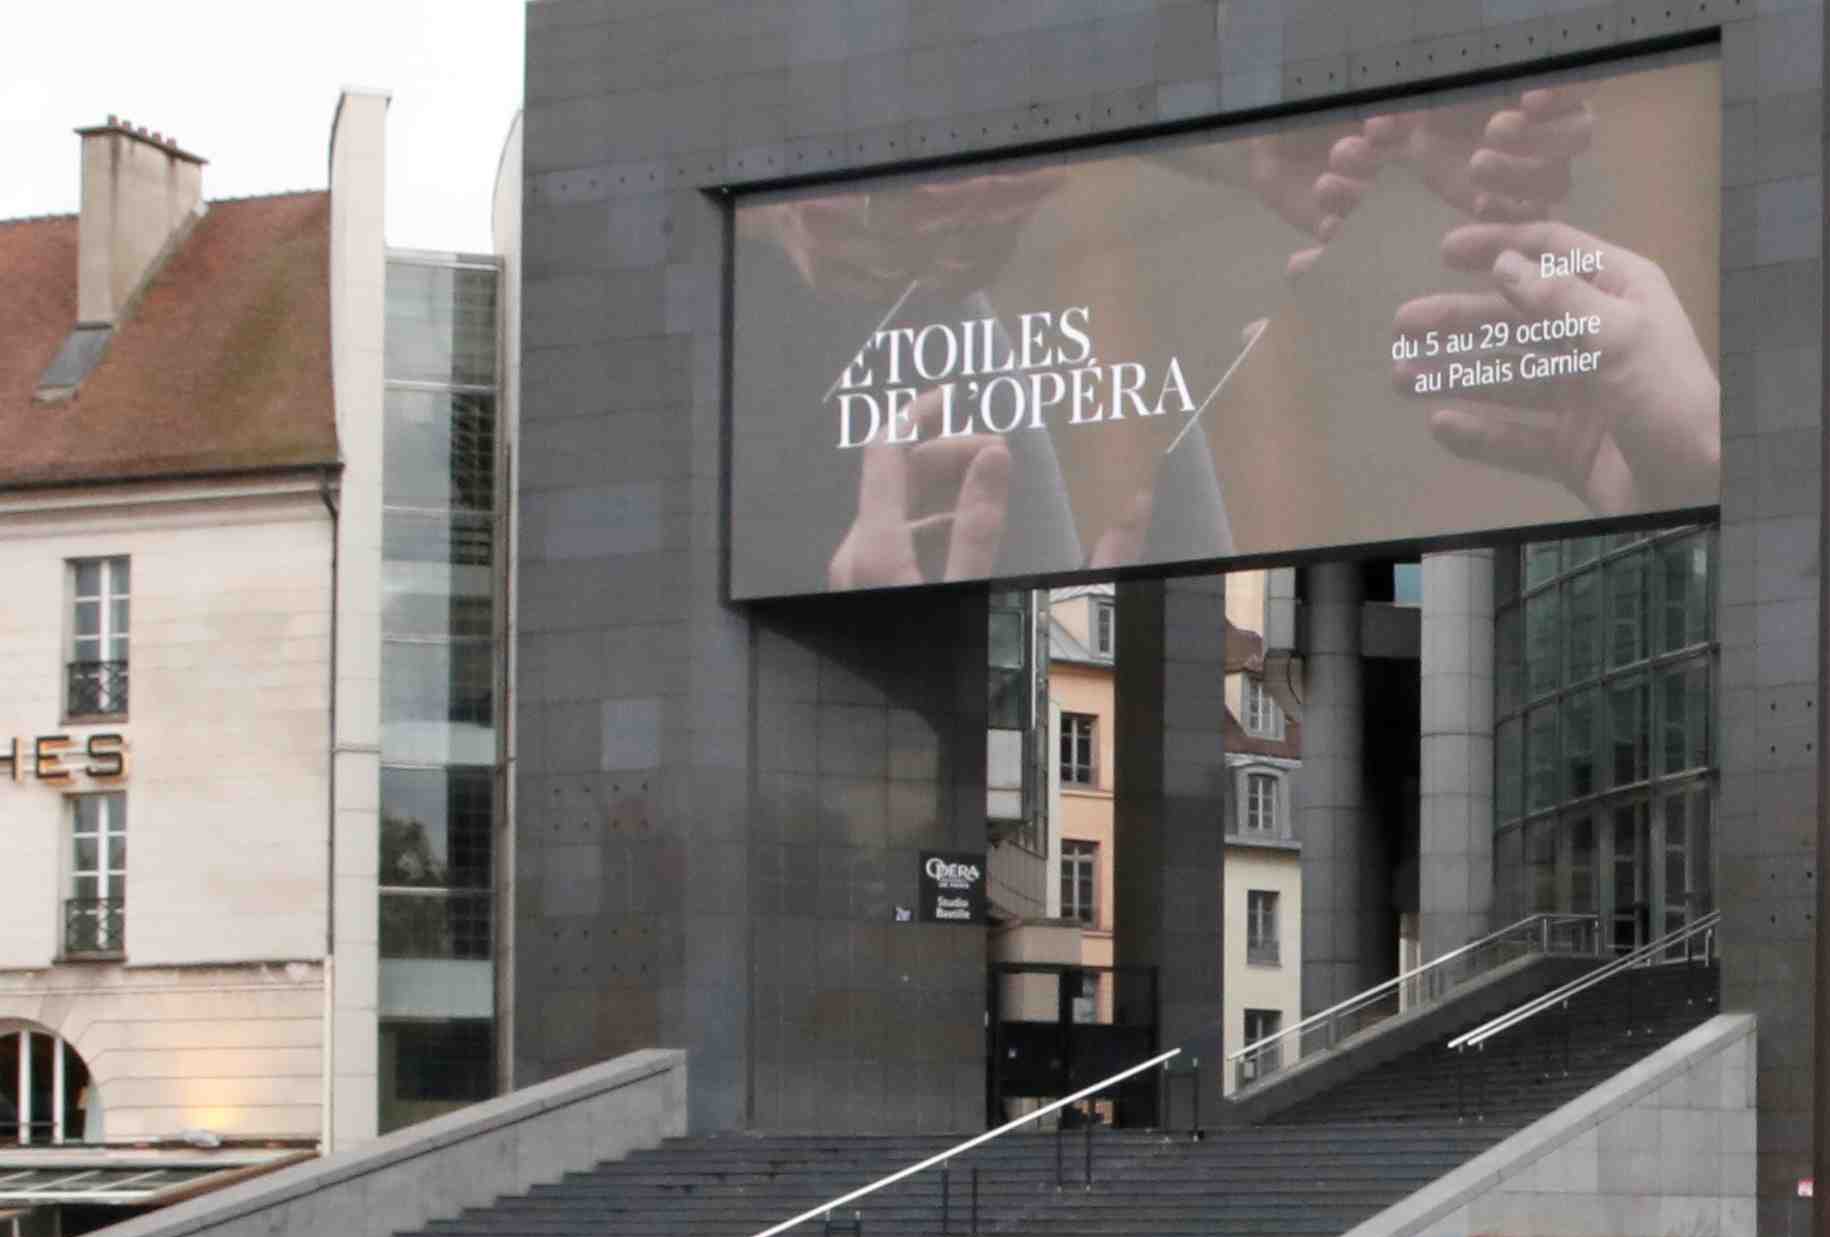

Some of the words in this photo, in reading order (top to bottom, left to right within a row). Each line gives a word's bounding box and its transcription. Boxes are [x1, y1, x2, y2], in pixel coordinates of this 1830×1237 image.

[1540, 248, 1604, 278] Ballet
[1391, 334, 1418, 360] du
[1426, 331, 1440, 356] 5
[1446, 331, 1473, 354] au
[1479, 322, 1509, 350] 29
[1516, 311, 1601, 344] octobre
[1414, 370, 1441, 393] au
[1449, 359, 1513, 388] Palais
[1519, 349, 1602, 380] Garnier
[835, 388, 919, 449] DE
